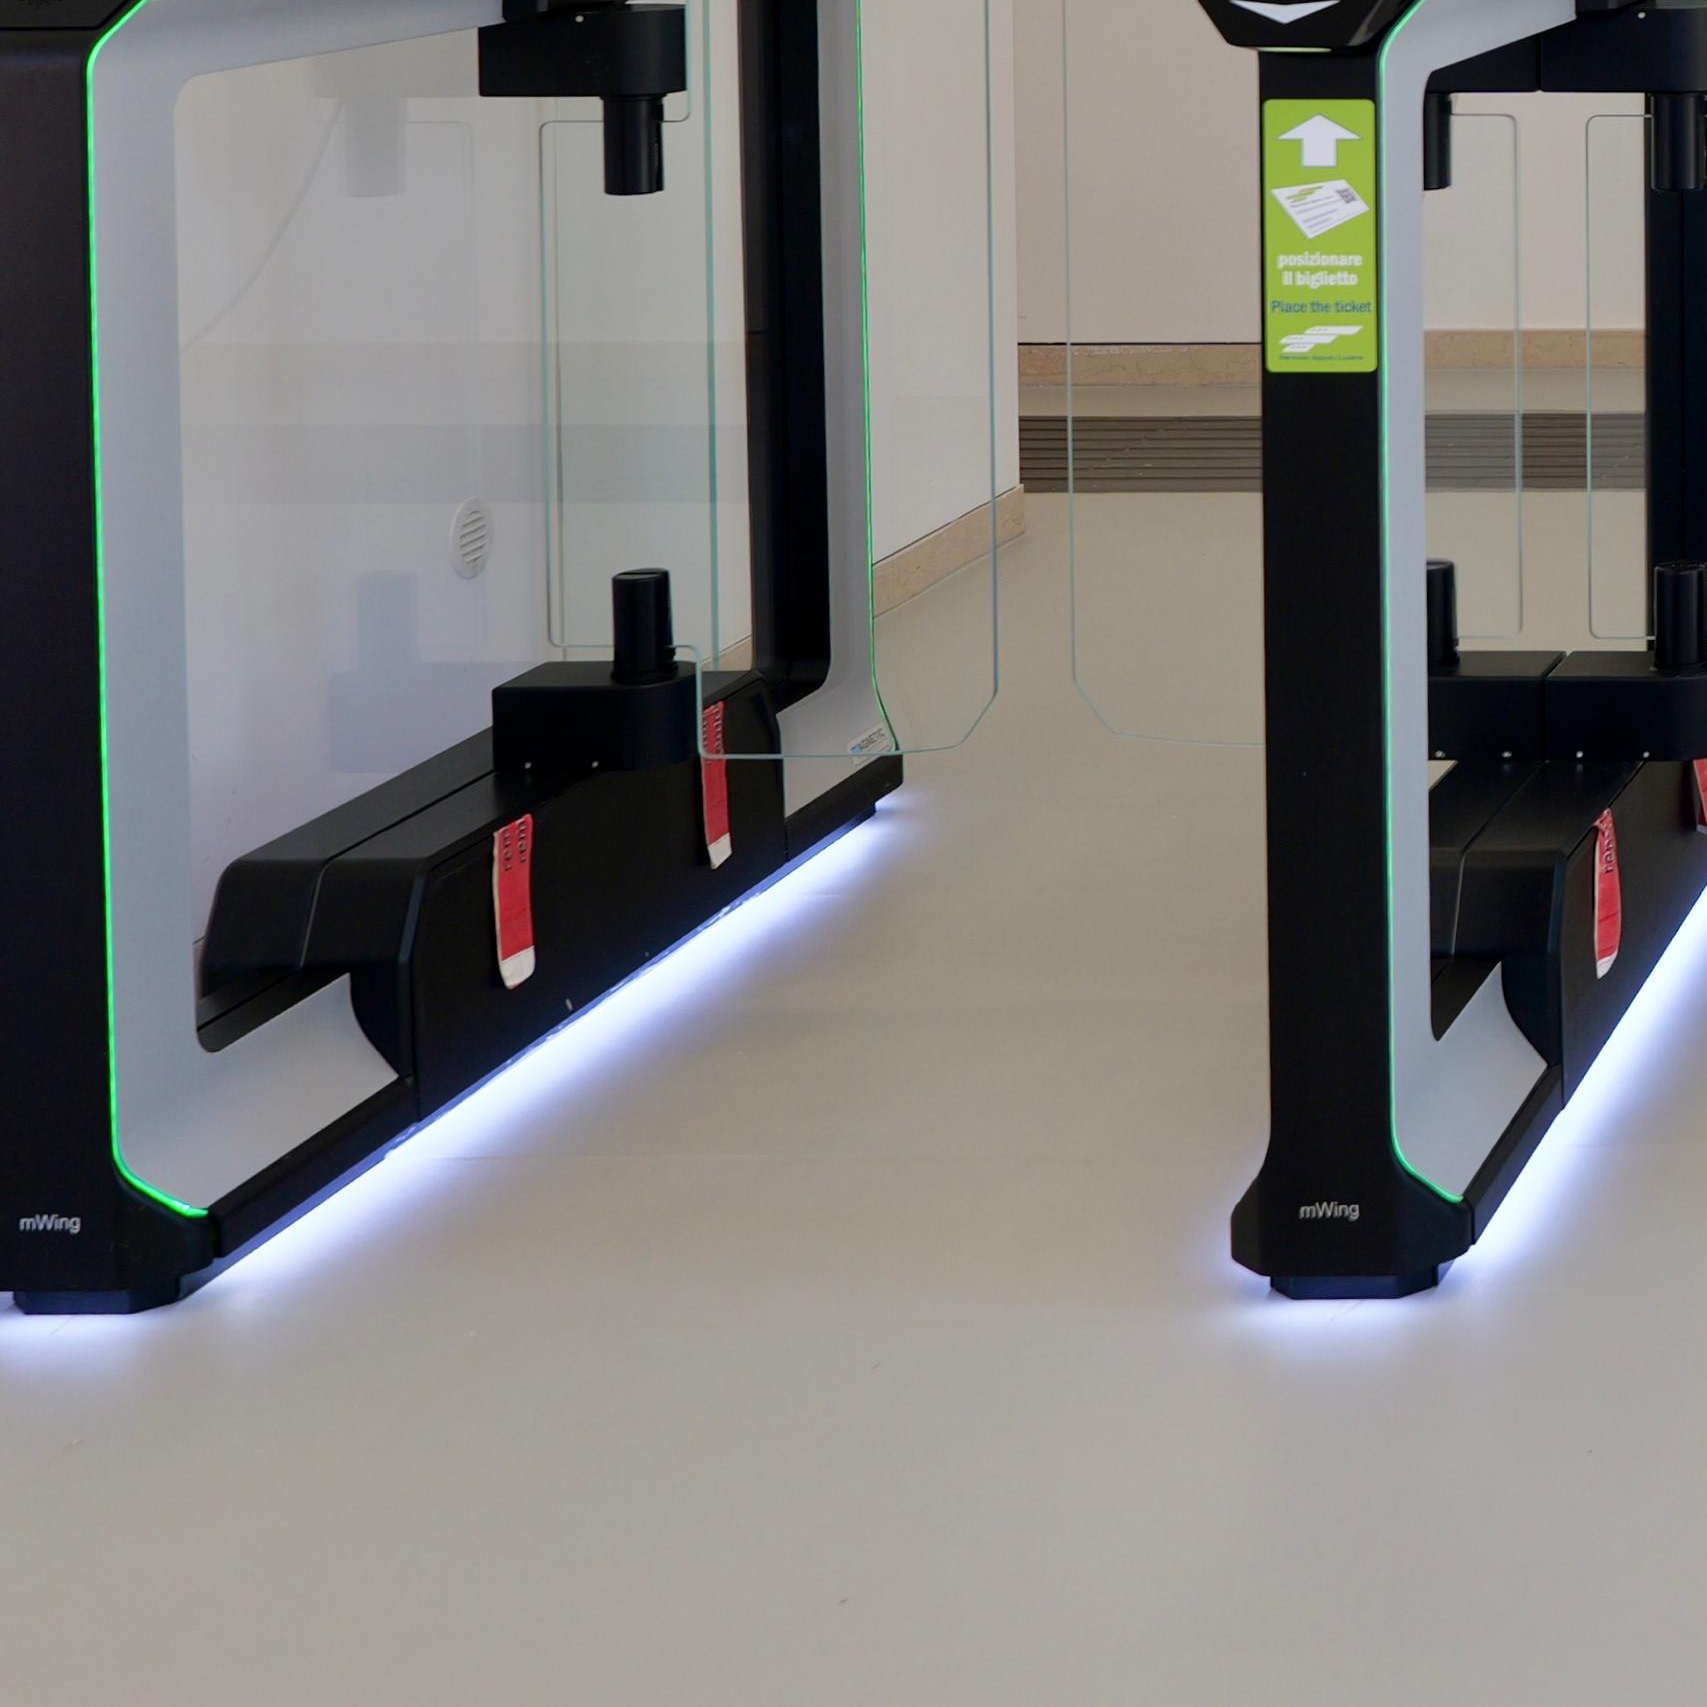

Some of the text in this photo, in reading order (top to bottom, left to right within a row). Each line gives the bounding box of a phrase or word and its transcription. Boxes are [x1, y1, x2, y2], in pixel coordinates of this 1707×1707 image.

[1277, 252, 1363, 269] posizionare
[1282, 269, 1358, 289] il biglietto
[1271, 300, 1371, 313] Place the ticket
[1299, 1201, 1360, 1222] mWing
[19, 1214, 81, 1235] mWing
